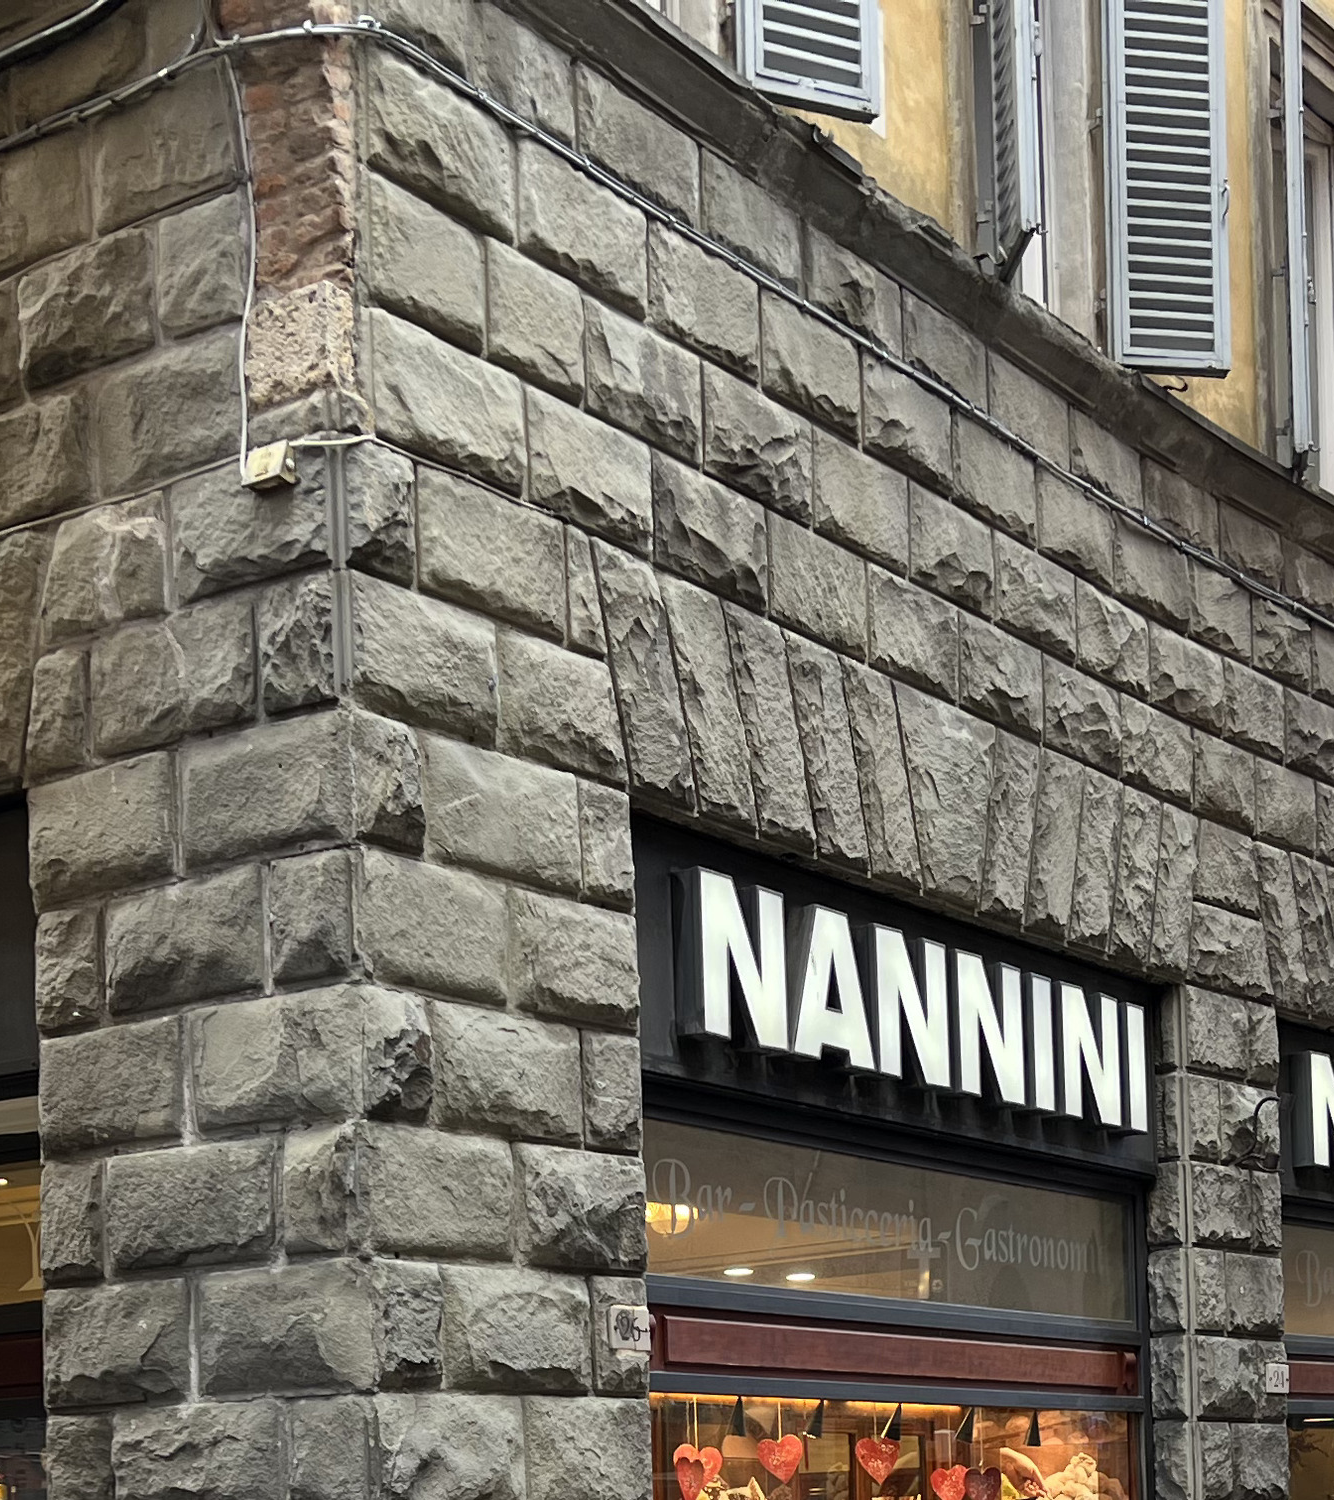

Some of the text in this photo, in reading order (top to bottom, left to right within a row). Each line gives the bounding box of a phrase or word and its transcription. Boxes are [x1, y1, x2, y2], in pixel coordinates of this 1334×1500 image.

[699, 868, 1148, 1134] NANNINI
[652, 1158, 733, 1239] Bar
[764, 1176, 933, 1253] Pasticceria
